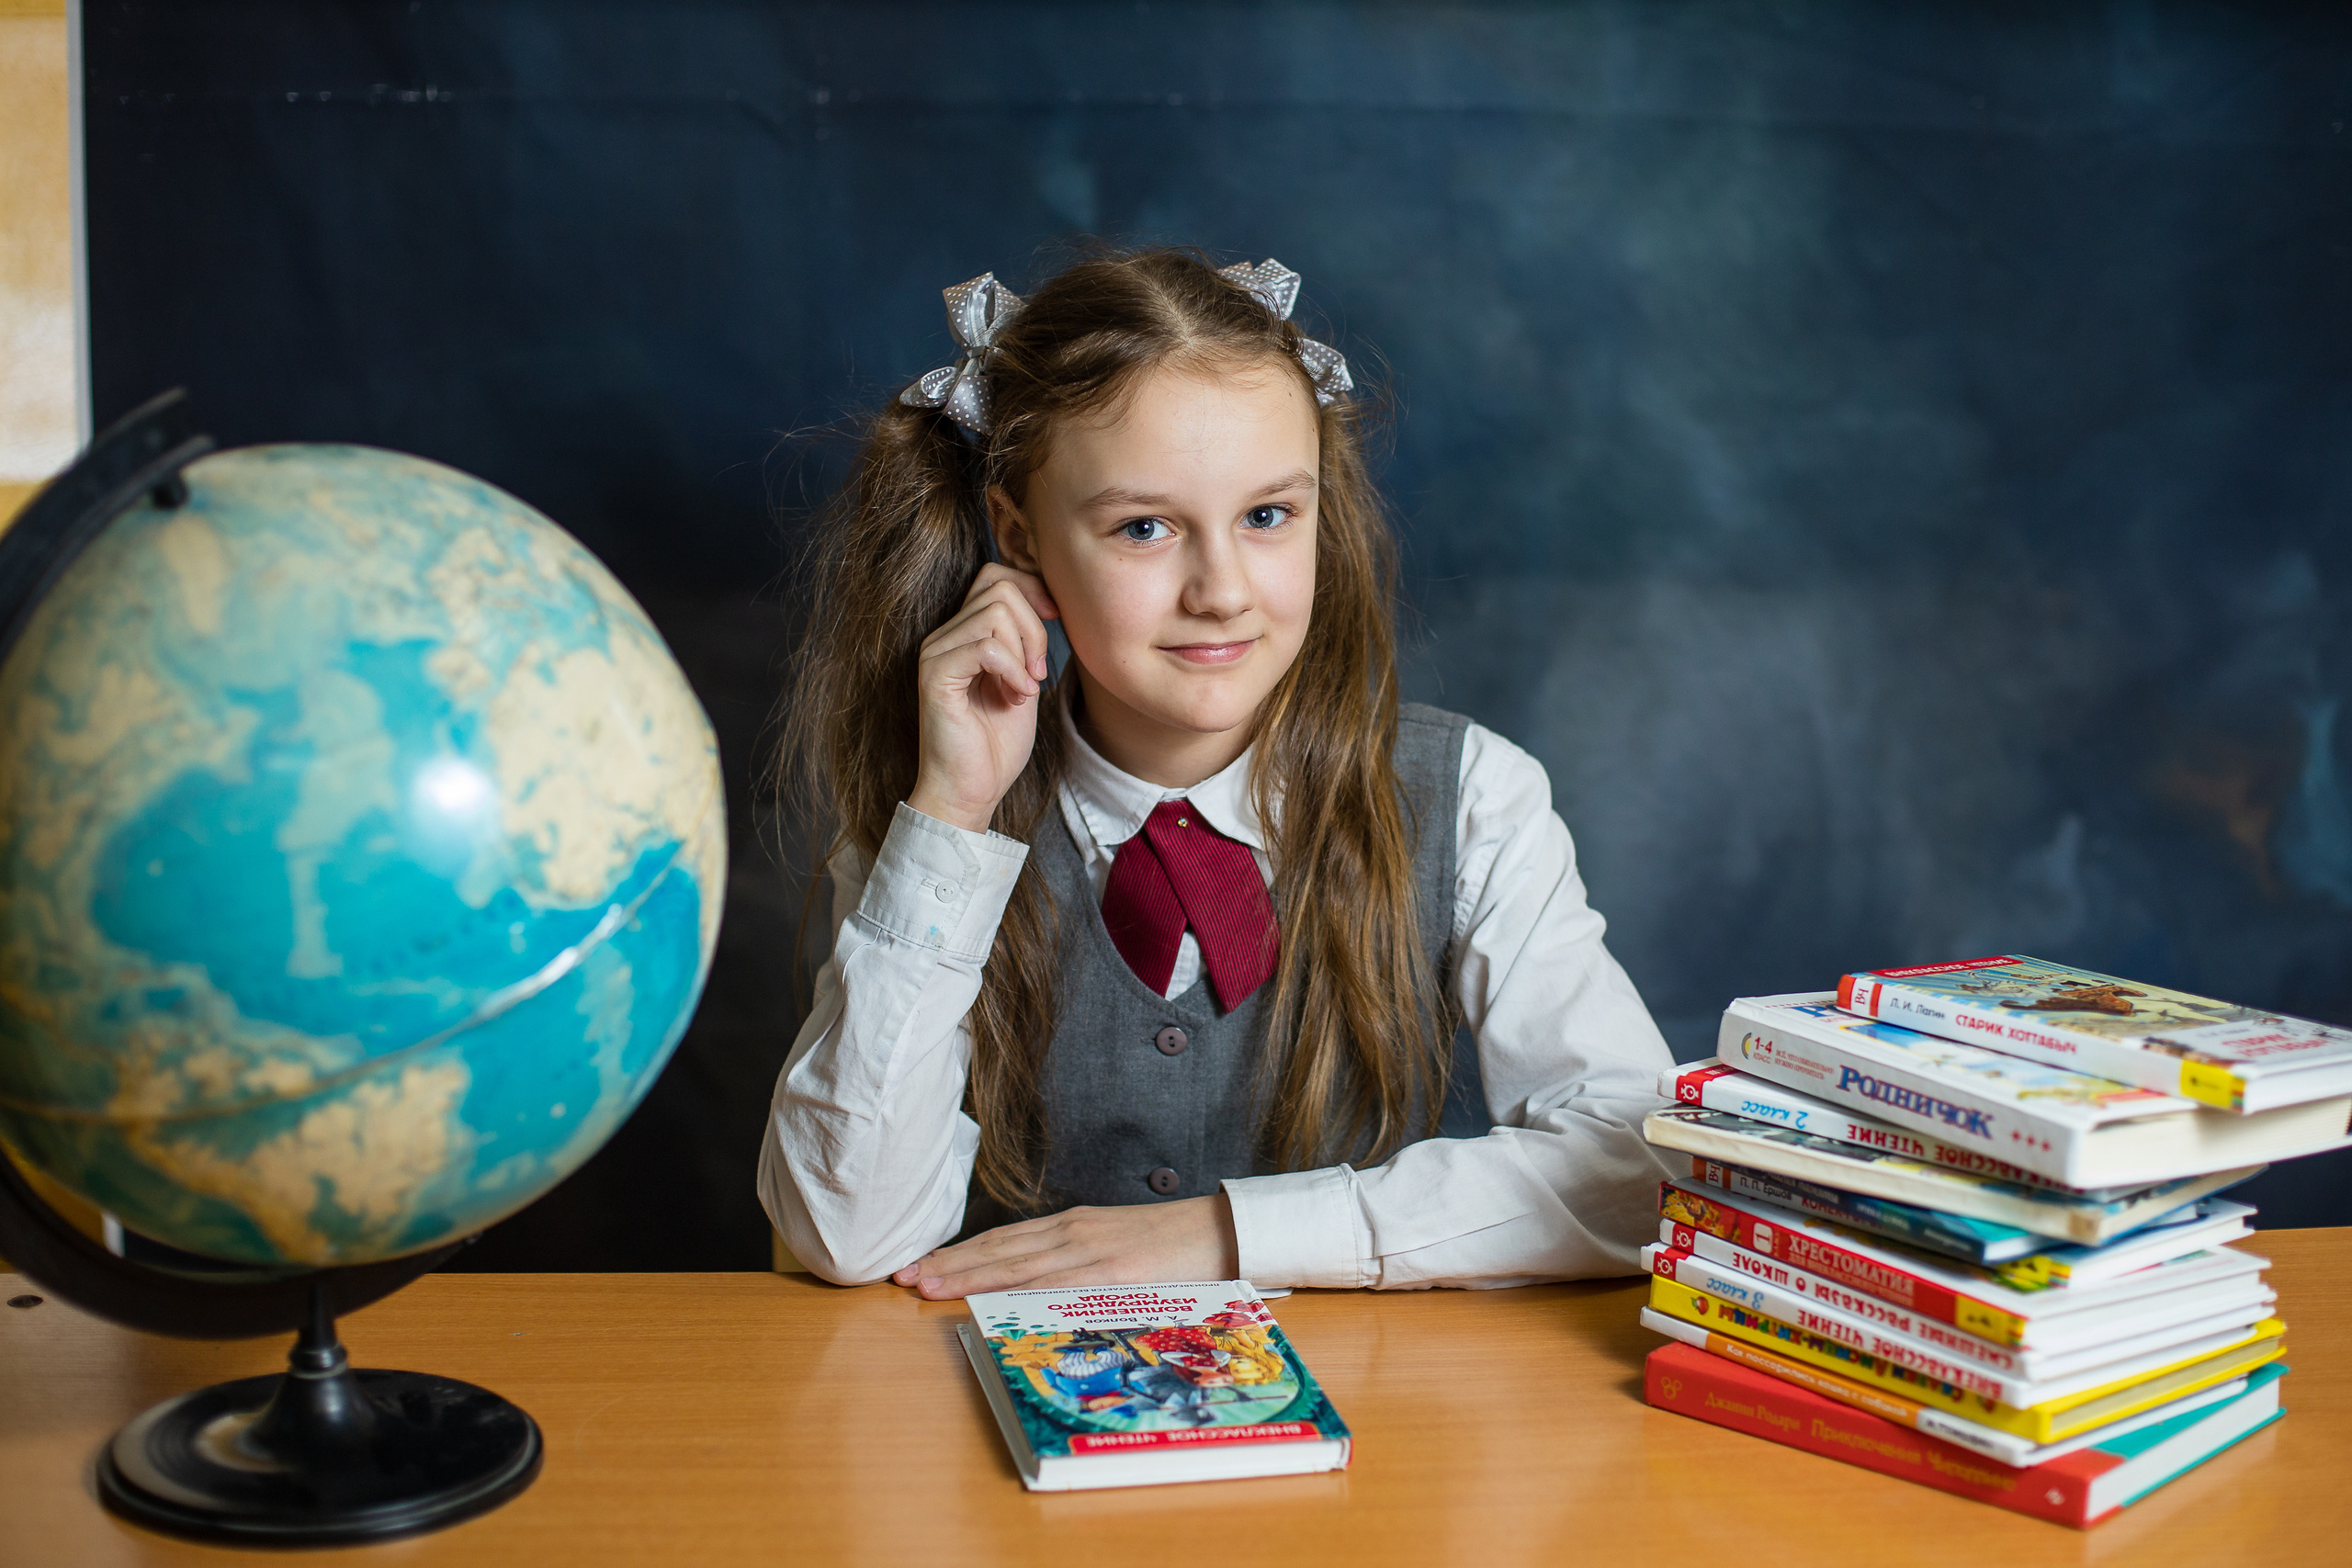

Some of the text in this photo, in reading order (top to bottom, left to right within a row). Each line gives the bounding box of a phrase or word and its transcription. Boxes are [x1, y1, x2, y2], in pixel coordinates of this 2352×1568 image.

[1854, 988, 1869, 1005] ВЧ
[1754, 1036, 1772, 1054] 1-4
[1955, 1014, 2077, 1054] СТАРИК ХОТТАБЫЧ
[1753, 1052, 1771, 1064] КЛАСС
[1741, 1100, 1808, 1129] 2 класс
[1836, 1065, 1995, 1140] РОДНИЧОК
[1847, 1123, 1925, 1156] ЧТЕНИЕ
[1709, 1165, 1721, 1184] ВЧ
[1740, 1177, 1749, 1189] П.
[1751, 1180, 1760, 1192] П.
[1763, 1183, 1792, 1201] Ершов
[1733, 1252, 1789, 1285] ШКОЛЕ
[1789, 1235, 1914, 1294] ХРЕСТОМАТИЯ
[1078, 1292, 1159, 1302] ГОРОДА
[1706, 1278, 1764, 1310] 3 класс
[1795, 1277, 1806, 1292] О
[1047, 1297, 1198, 1311] ИЗУМРУДНОГО
[1060, 1305, 1193, 1318] ВОЛШЕБНИК
[1797, 1308, 2003, 1400] ВНЕКЛАССНОЕ ЧТЕНИЕ
[1919, 1323, 2014, 1370] СМЕШНЫЕ
[1726, 1344, 1744, 1358] Как
[1746, 1352, 1815, 1384] поссорились
[1085, 1424, 1302, 1448] ВНЕКЛАССНОЕ ЧТЕНИЕ
[1705, 1392, 1755, 1417] Джанни
[1757, 1404, 1801, 1432] Родари
[1811, 1417, 1922, 1465] Приключения
